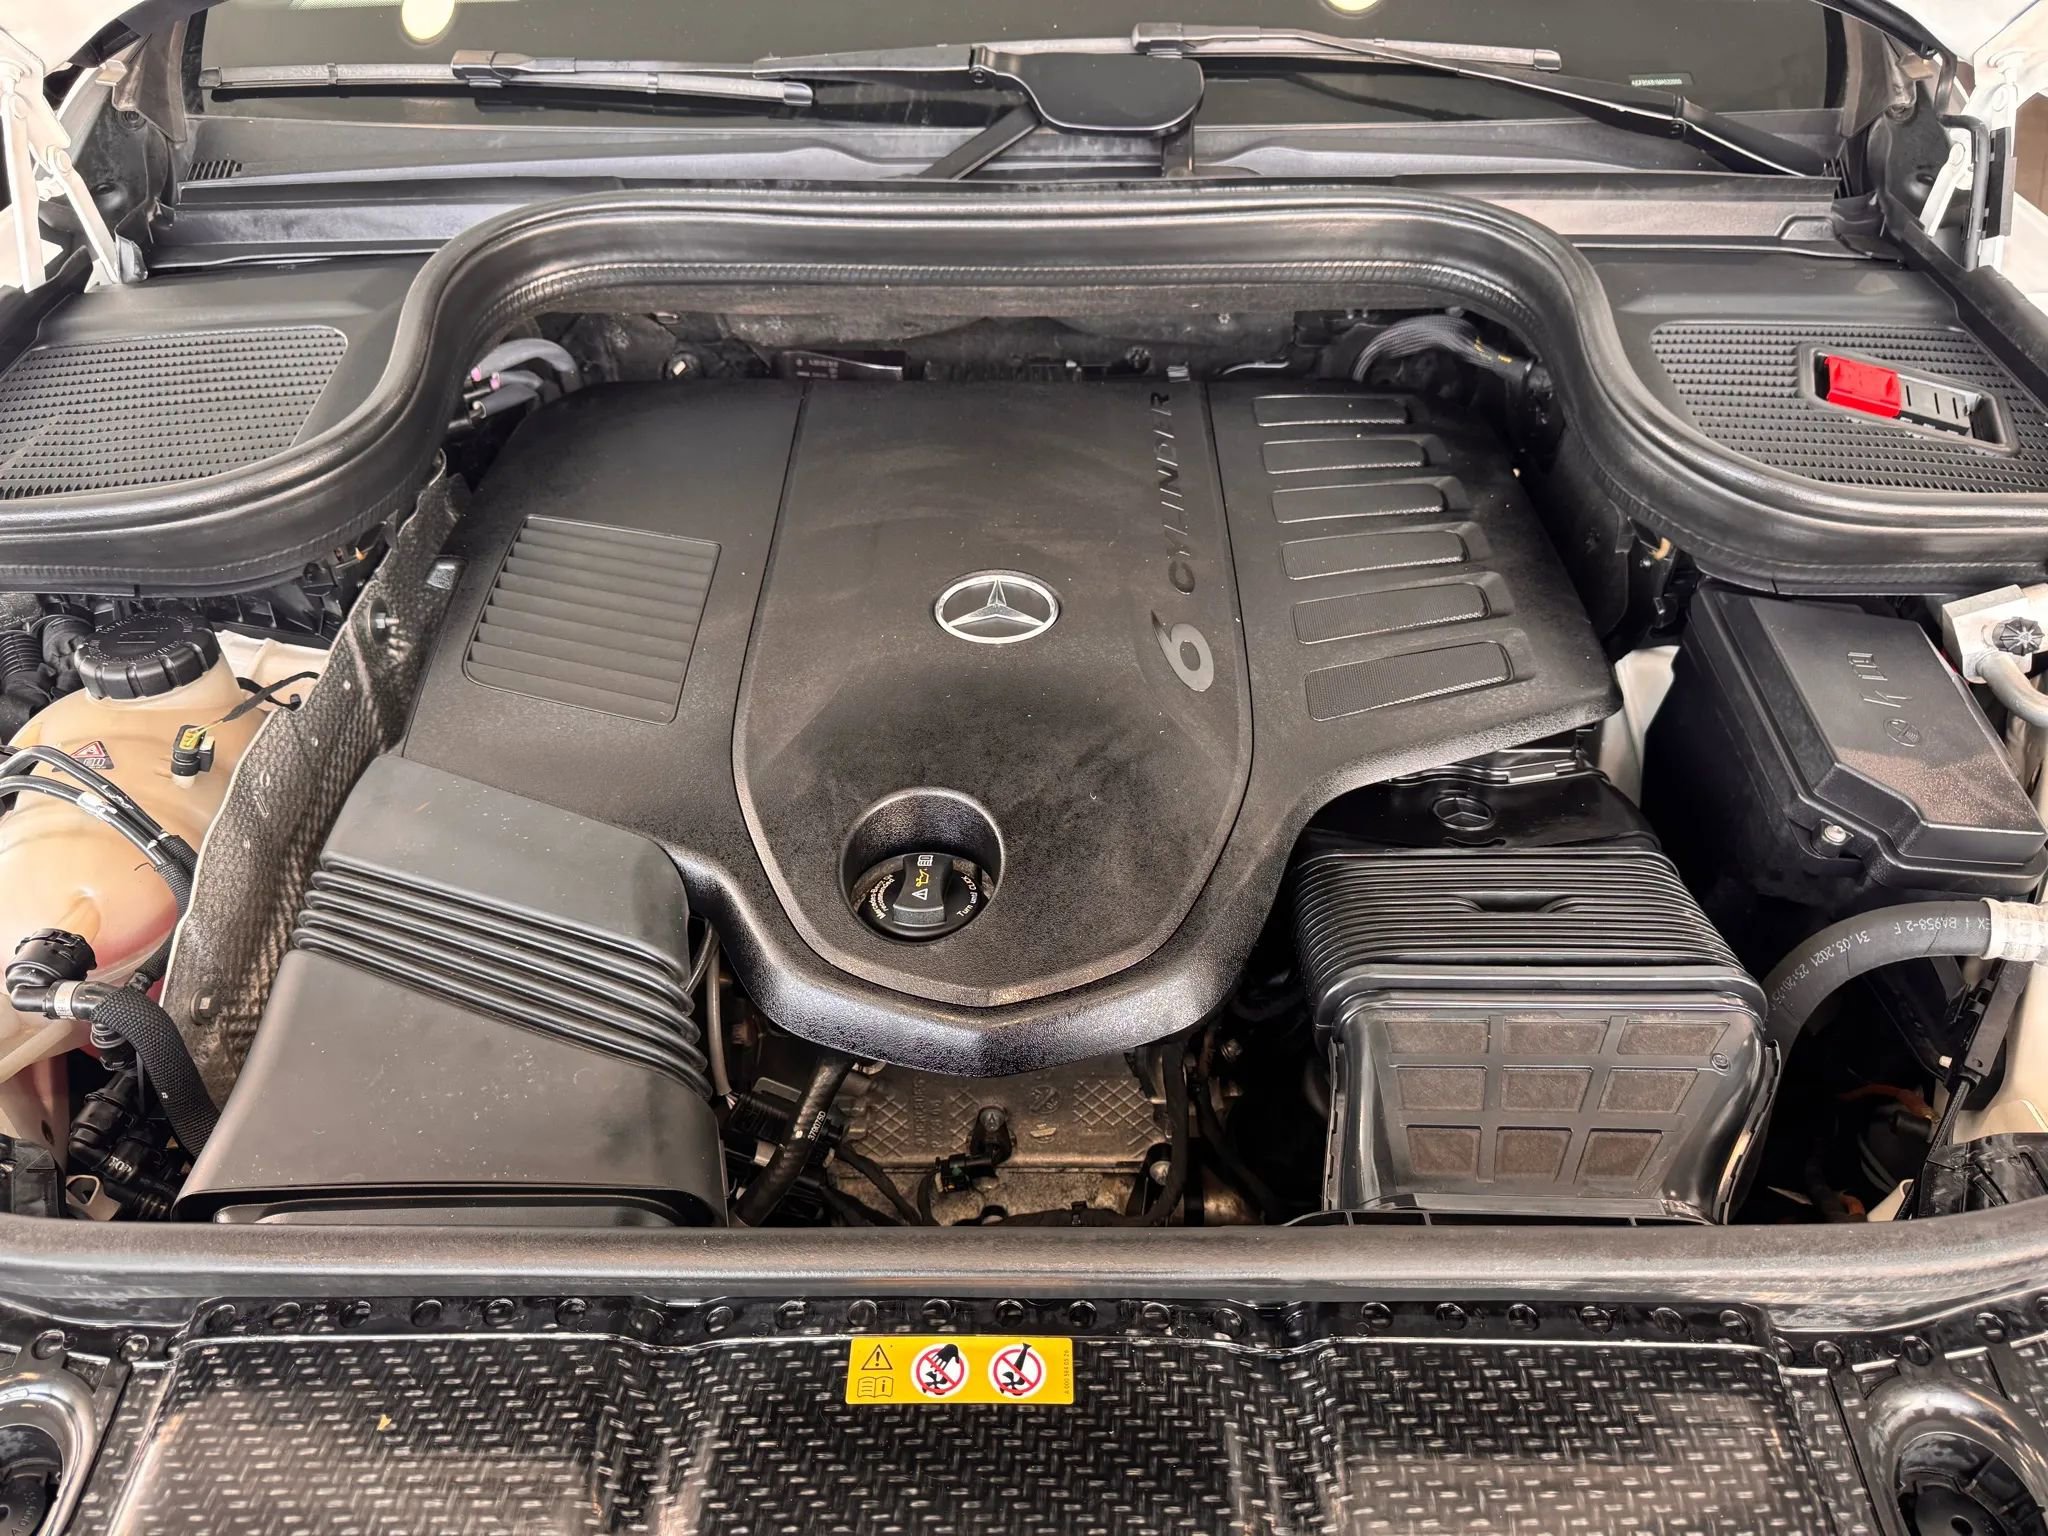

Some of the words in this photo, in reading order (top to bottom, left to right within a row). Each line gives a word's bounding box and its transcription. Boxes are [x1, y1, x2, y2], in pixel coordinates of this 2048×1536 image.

[1150, 392, 1196, 595] CYLINDER
[1150, 610, 1215, 692] 6
[956, 904, 974, 917] Turn
[1809, 930, 1870, 966] 31.03.2021
